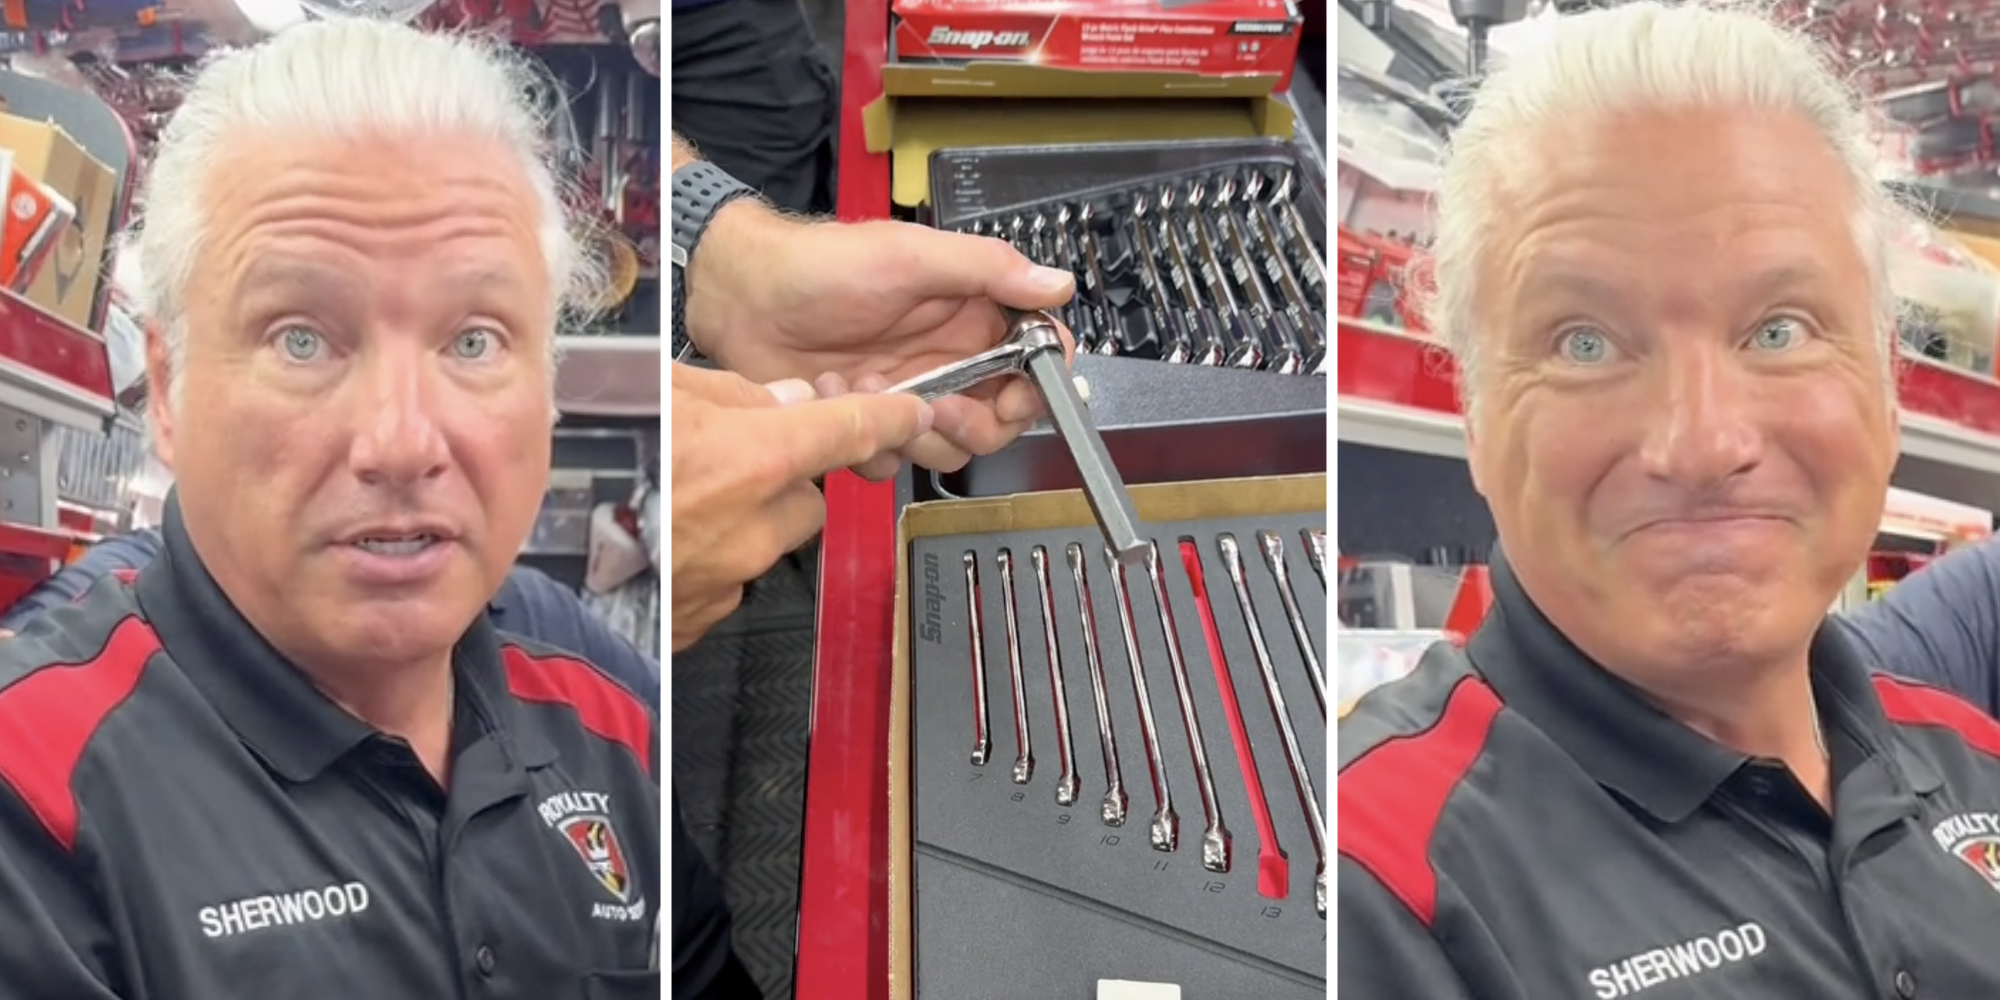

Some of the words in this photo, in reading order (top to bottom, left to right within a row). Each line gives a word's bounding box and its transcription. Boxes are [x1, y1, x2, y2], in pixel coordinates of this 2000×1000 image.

[928, 25, 1030, 50] Snap-on
[920, 552, 947, 645] Snap-on
[1010, 791, 1026, 802] 8
[537, 791, 609, 828] ROYALTY
[1056, 814, 1072, 825] 9
[1100, 834, 1121, 846] 10
[1154, 860, 1169, 872] 11
[1203, 881, 1226, 893] 12
[198, 881, 370, 938] SHERWOOD
[591, 902, 627, 921] AUTO
[1260, 906, 1283, 919] 13
[1588, 921, 1767, 1000] SHERWOOD
